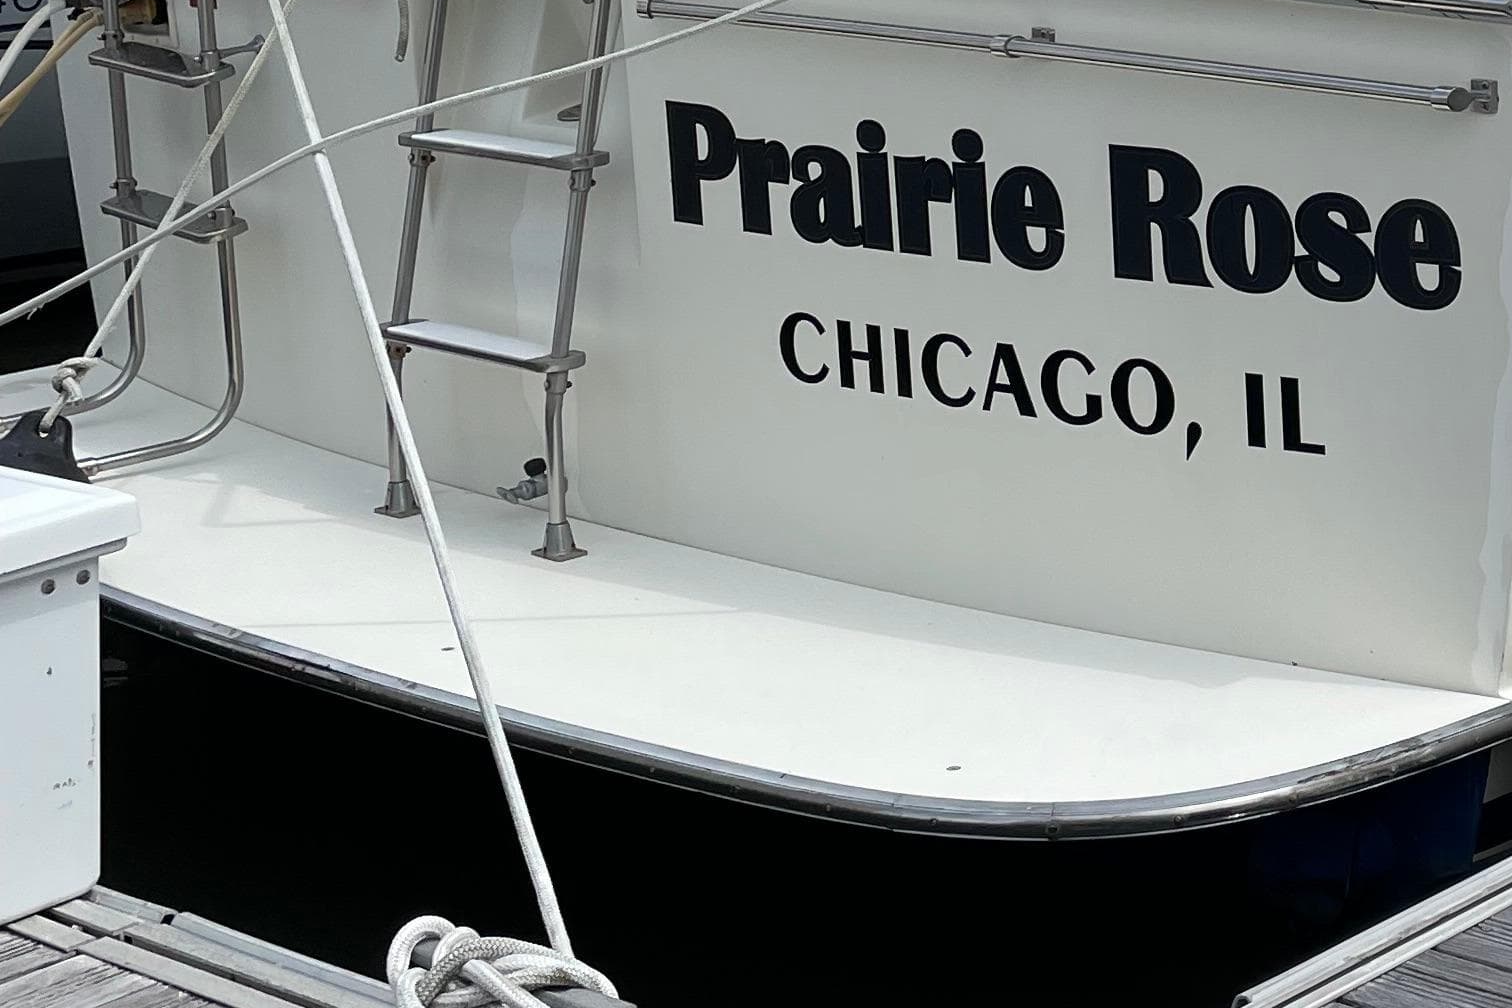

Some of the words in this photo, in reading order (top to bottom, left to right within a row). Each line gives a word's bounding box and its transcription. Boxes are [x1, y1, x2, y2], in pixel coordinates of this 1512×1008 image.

[664, 99, 1065, 272] Prairie
[1108, 143, 1462, 311] Rose
[779, 311, 1202, 461] CHICAGO,
[1244, 372, 1326, 456] IL
